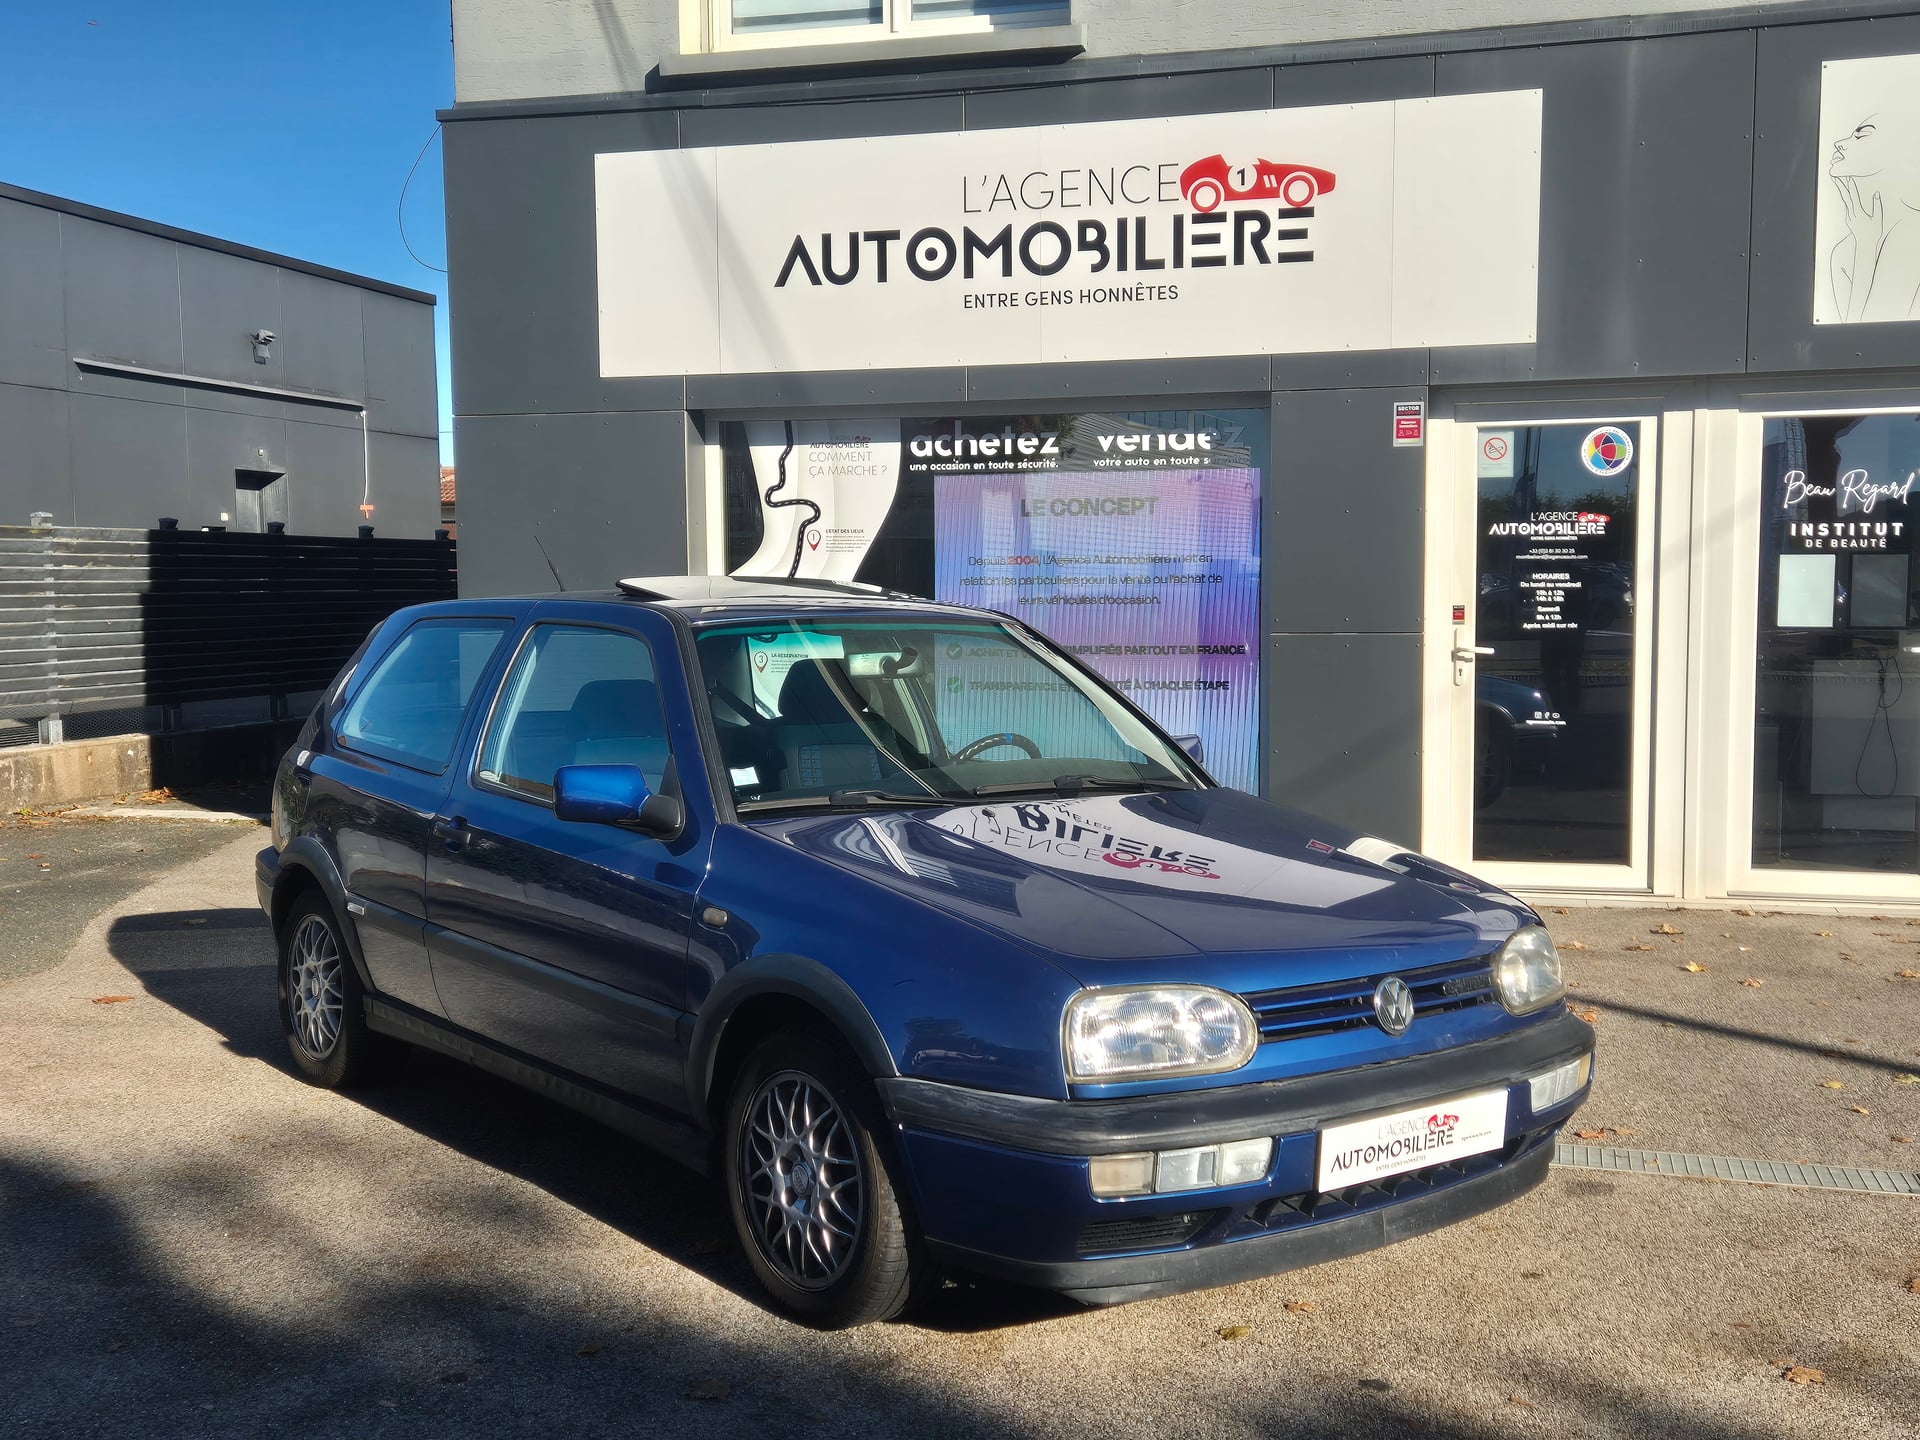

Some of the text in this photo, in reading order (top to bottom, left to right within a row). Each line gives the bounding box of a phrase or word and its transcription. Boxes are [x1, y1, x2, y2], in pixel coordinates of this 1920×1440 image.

[963, 162, 1180, 214] L'AGENCE
[963, 281, 1179, 309] ENTRE GENS HONNÊTES
[909, 420, 1059, 457] achetez
[808, 451, 873, 463] COMMENT
[909, 457, 1059, 471] une occasion en toute sécurité.
[1093, 455, 1122, 467] votre
[1124, 456, 1150, 467] auto
[1153, 457, 1167, 466] en
[1169, 455, 1200, 466] toute
[808, 464, 888, 479] ÇA MARCHE ?
[1783, 468, 1916, 514] Beau Regard
[1020, 495, 1159, 518] LE CONCEPT
[1530, 511, 1579, 521] L'AGENCE
[1790, 522, 1904, 537] INSTITUT
[1805, 536, 1888, 548] DE BEAUTÉ
[968, 555, 1006, 568] Depuis
[1043, 555, 1091, 567] L'Agence
[1093, 553, 1171, 564] Automobilière
[1198, 554, 1213, 563] en
[959, 575, 1000, 586] relation
[1001, 575, 1017, 586] les
[1019, 575, 1080, 588] particuliers
[1081, 576, 1107, 587] pour
[1153, 576, 1168, 584] ou
[1169, 573, 1206, 584] l'achat
[1207, 573, 1223, 584] de
[1532, 572, 1571, 580] HORAIRES
[1018, 594, 1161, 605] leurs véhicules d'occasion.
[1124, 645, 1177, 655] PARTOUT
[1178, 645, 1196, 655] EN
[1197, 645, 1246, 655] FRANCE
[969, 681, 1058, 692] TRANSPARENCE
[1133, 678, 1142, 690] À
[1143, 680, 1193, 691] CHAQUE
[1193, 677, 1231, 690] ÉTAPE
[1377, 1115, 1429, 1140] L'AGENCE
